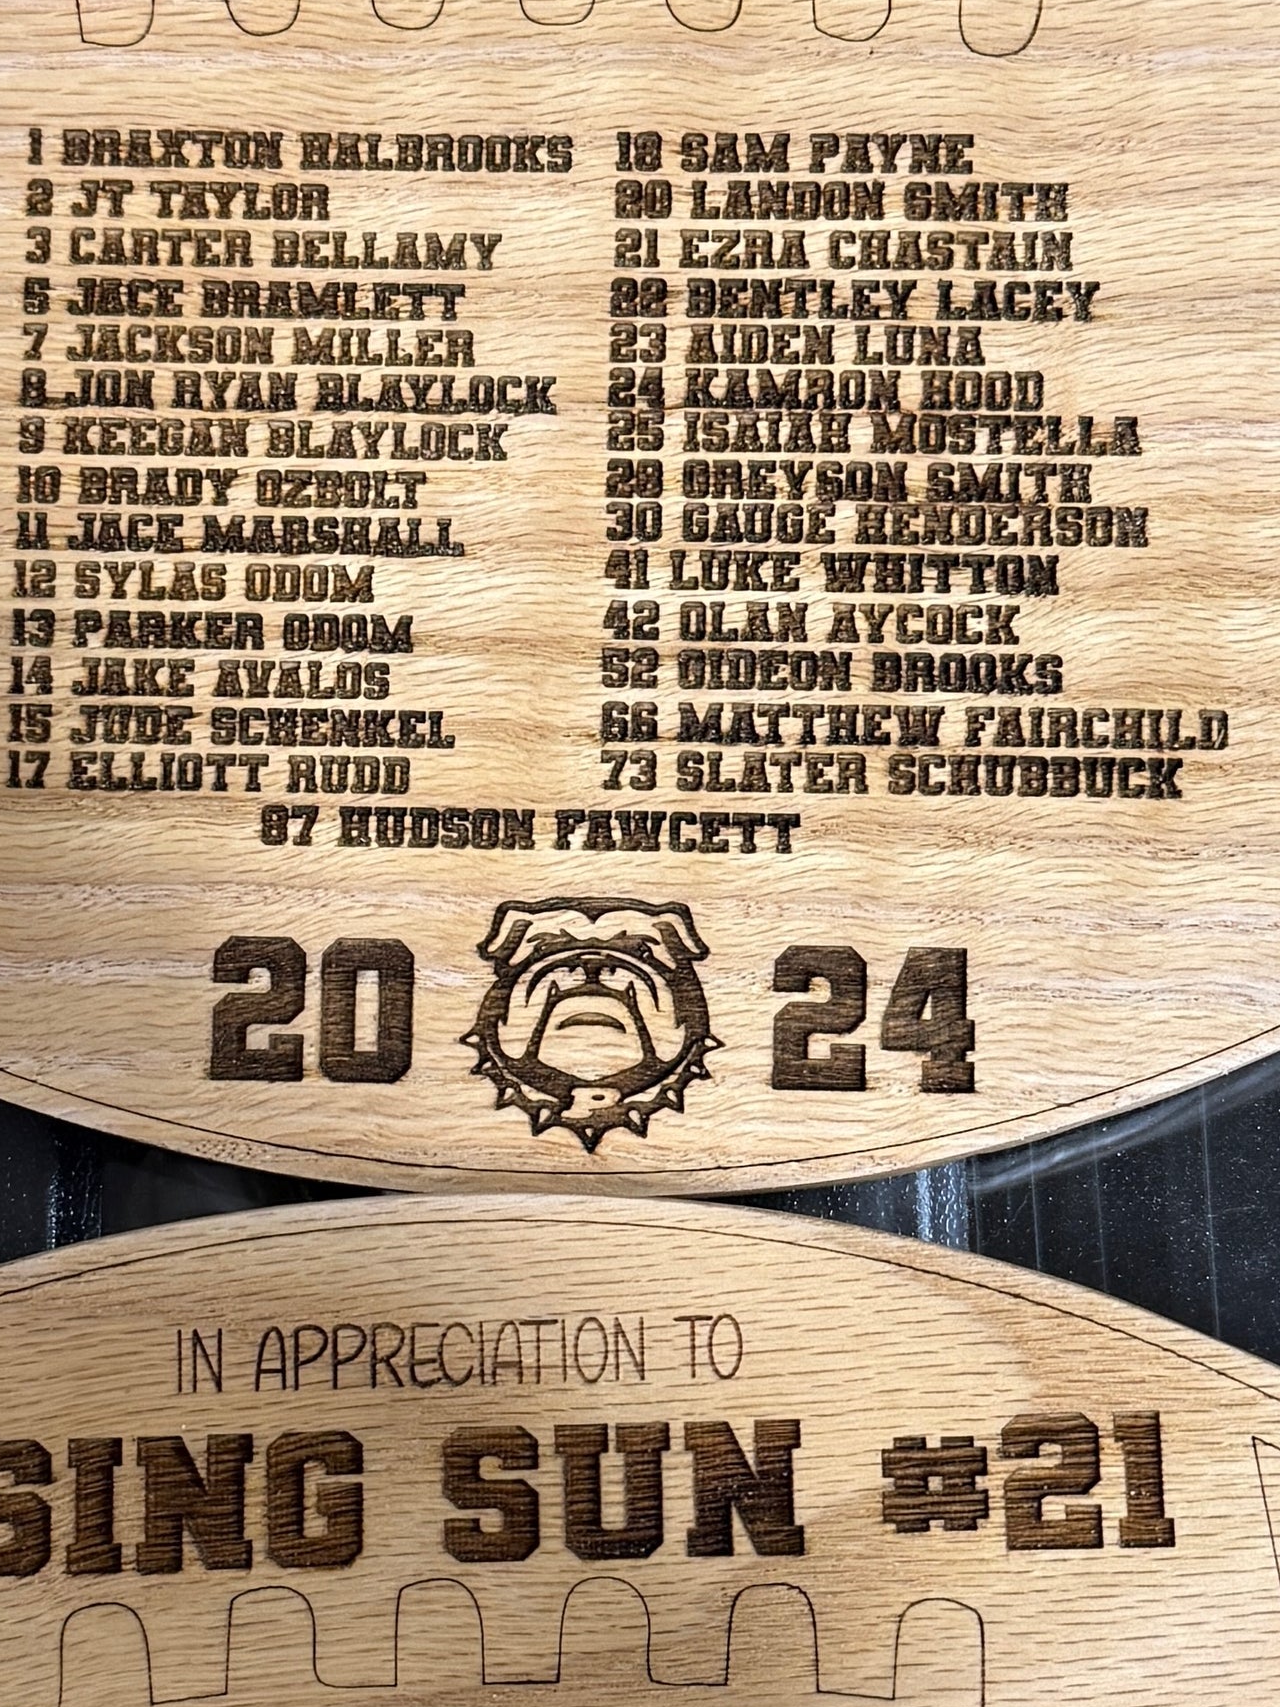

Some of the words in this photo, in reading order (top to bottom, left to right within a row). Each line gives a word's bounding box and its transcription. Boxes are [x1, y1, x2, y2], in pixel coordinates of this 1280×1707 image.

[615, 132, 662, 171] 18
[680, 132, 790, 172] SAM
[809, 133, 974, 174] PAYNE
[614, 181, 672, 219] 20
[690, 181, 884, 220] LANDON
[904, 182, 1069, 221] SMITH
[614, 229, 659, 268] 21
[679, 229, 810, 269] EZRA
[829, 231, 1072, 271] CHASTAIN
[687, 279, 917, 320] BENTLEY
[936, 281, 1099, 322] LACEY
[609, 324, 666, 362] 23
[685, 325, 835, 365] AIDEN
[853, 326, 985, 366] LUNA
[608, 369, 664, 407] 24
[682, 370, 901, 410] KAMRON
[921, 371, 1044, 411] HOOD
[606, 413, 663, 450] 25
[682, 413, 851, 453] ISAIAH
[870, 416, 1141, 457] MOSTELLA
[606, 460, 663, 498] 28
[682, 461, 908, 501] GREYSON
[927, 463, 1091, 503] SMITH
[606, 504, 662, 541] 30
[681, 504, 835, 544] GAUGE
[854, 506, 1149, 547] HENDERSON
[603, 551, 648, 589] 41
[668, 552, 800, 591] LUKE
[820, 553, 1059, 595] WHITTON
[603, 601, 660, 640] 42
[679, 602, 809, 642] OLAN
[828, 604, 1020, 645] AYCOCK
[601, 649, 659, 688] 52
[678, 650, 852, 691] GIDEON
[872, 652, 1063, 694] BROOKS
[601, 703, 659, 742] 66
[678, 704, 944, 746] MATTHEW
[965, 706, 1229, 750] FAIRCHILD
[600, 751, 658, 790] 73
[677, 752, 868, 794] SLATER
[888, 755, 1183, 798] SCHUBBUCK
[210, 936, 415, 1083] 20
[770, 945, 976, 1094] 24
[176, 1327, 226, 1394] IN
[252, 1318, 646, 1393] APPRECIATION
[676, 1312, 744, 1381] TO
[442, 1418, 808, 1560] SUN
[880, 1409, 1176, 1551] #21
